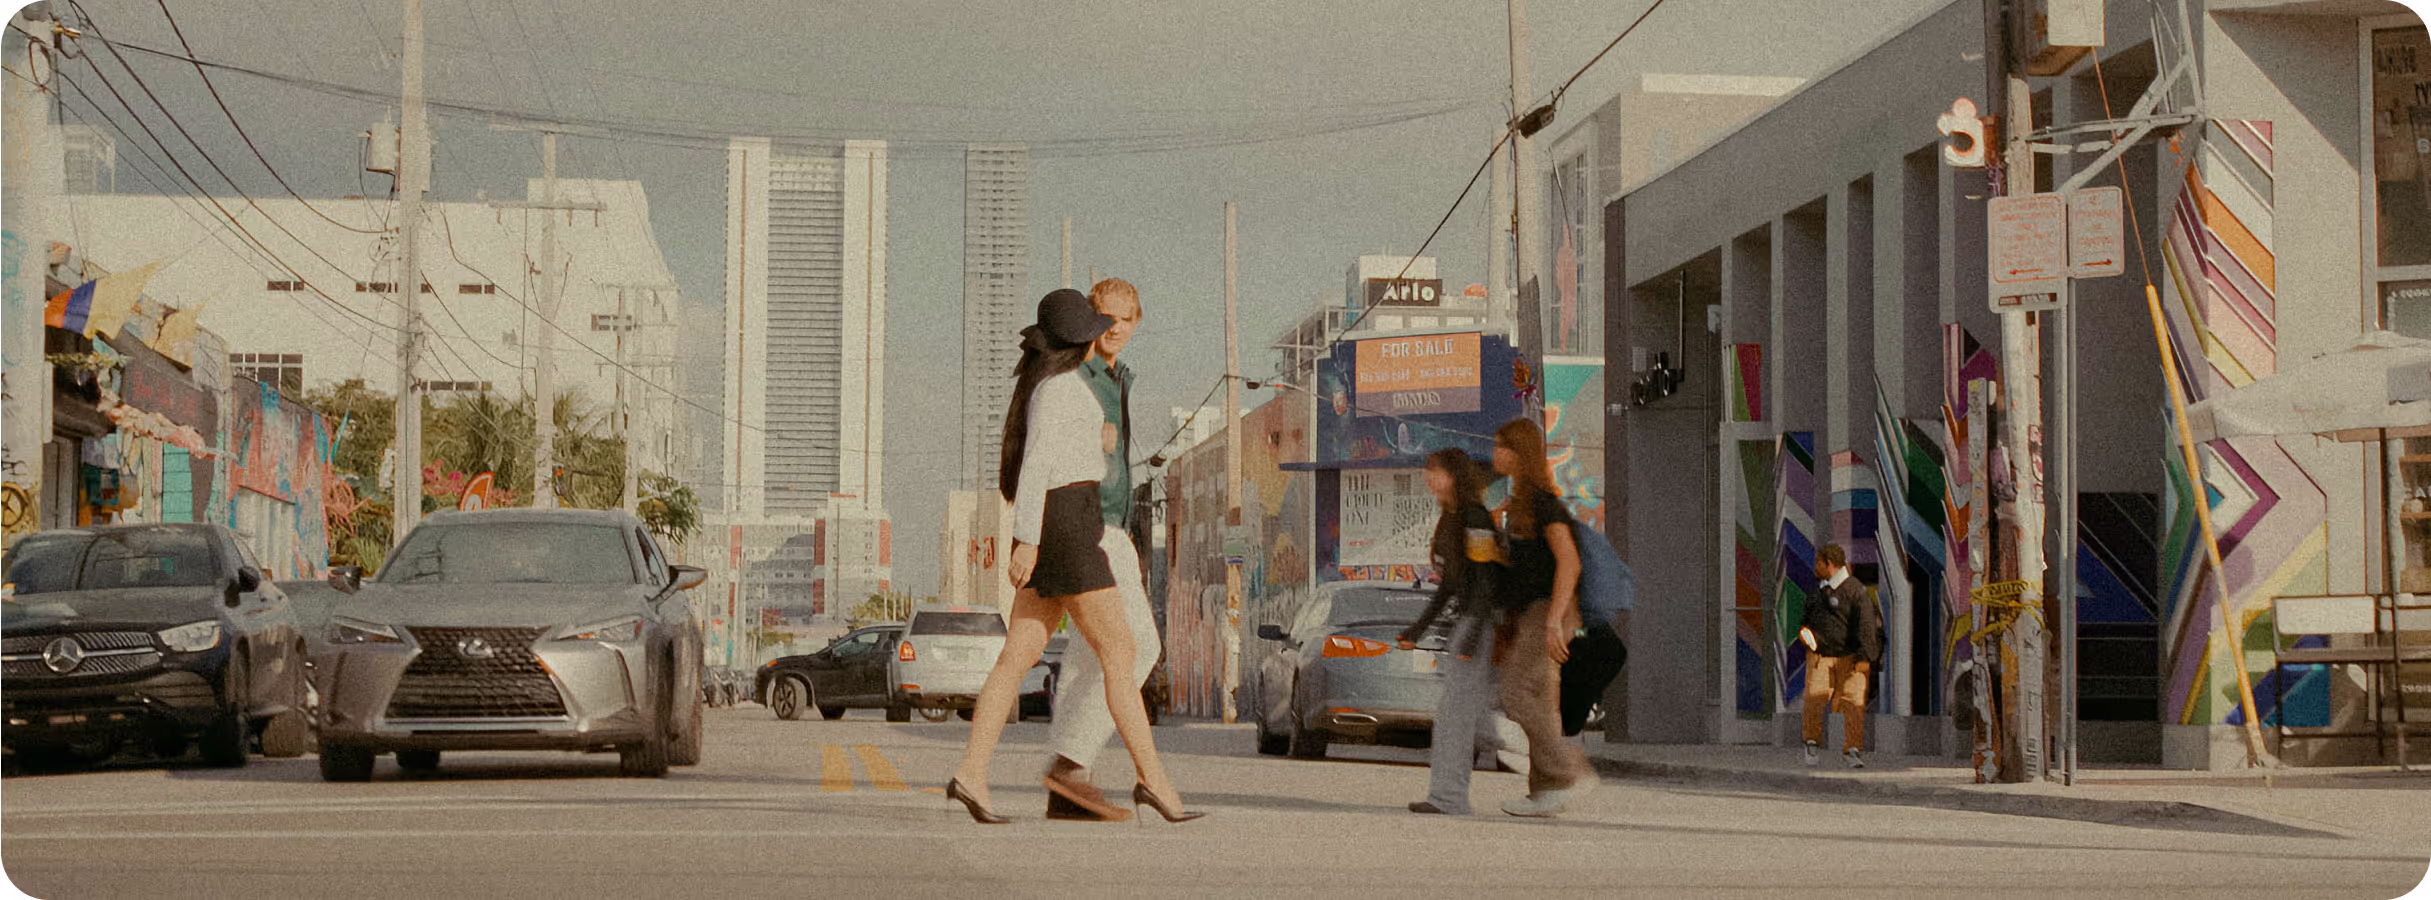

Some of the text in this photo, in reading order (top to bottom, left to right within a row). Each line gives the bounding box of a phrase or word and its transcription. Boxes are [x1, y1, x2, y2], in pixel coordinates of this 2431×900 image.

[1383, 281, 1434, 301] Arlo
[1382, 338, 1453, 357] FOR SALE
